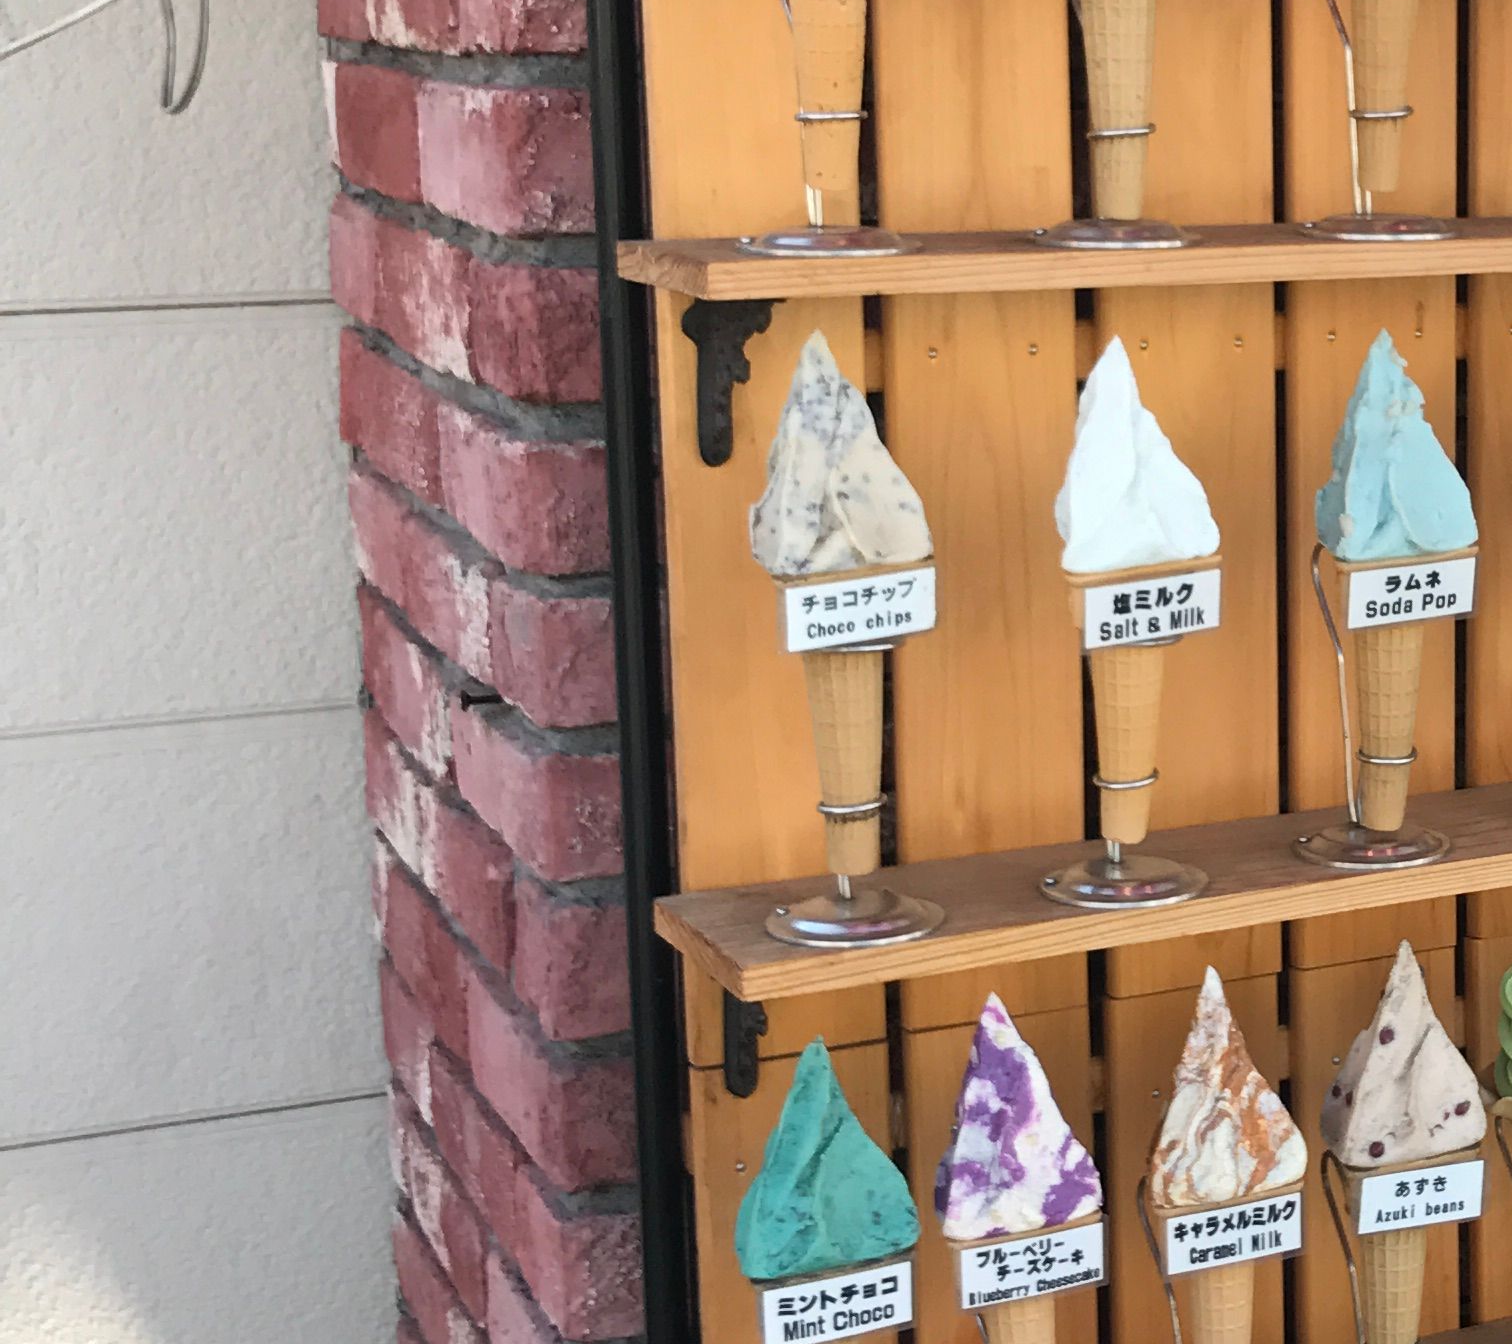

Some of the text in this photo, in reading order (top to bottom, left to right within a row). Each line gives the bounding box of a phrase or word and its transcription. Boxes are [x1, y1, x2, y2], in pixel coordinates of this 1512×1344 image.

[801, 577, 918, 615] チョコチップ
[1112, 581, 1195, 616] 塩ミルク
[1382, 570, 1442, 595] ラムネ
[1364, 589, 1458, 620] Soda Pop
[806, 608, 913, 640] Choco chips
[1098, 605, 1206, 642] Salt & Milk
[1394, 1174, 1448, 1198] あずき
[1172, 1199, 1298, 1243] キャラメルミルク
[1375, 1197, 1465, 1225] Azuki beans
[974, 1238, 1066, 1271] ブルーベリー
[1189, 1228, 1283, 1265] Caramel Milk
[996, 1247, 1085, 1282] チーズケーキ
[776, 1275, 900, 1316] ミントチョコ
[968, 1264, 1102, 1307] Blueberry Cheesecake
[782, 1301, 896, 1343] Mint Choco
